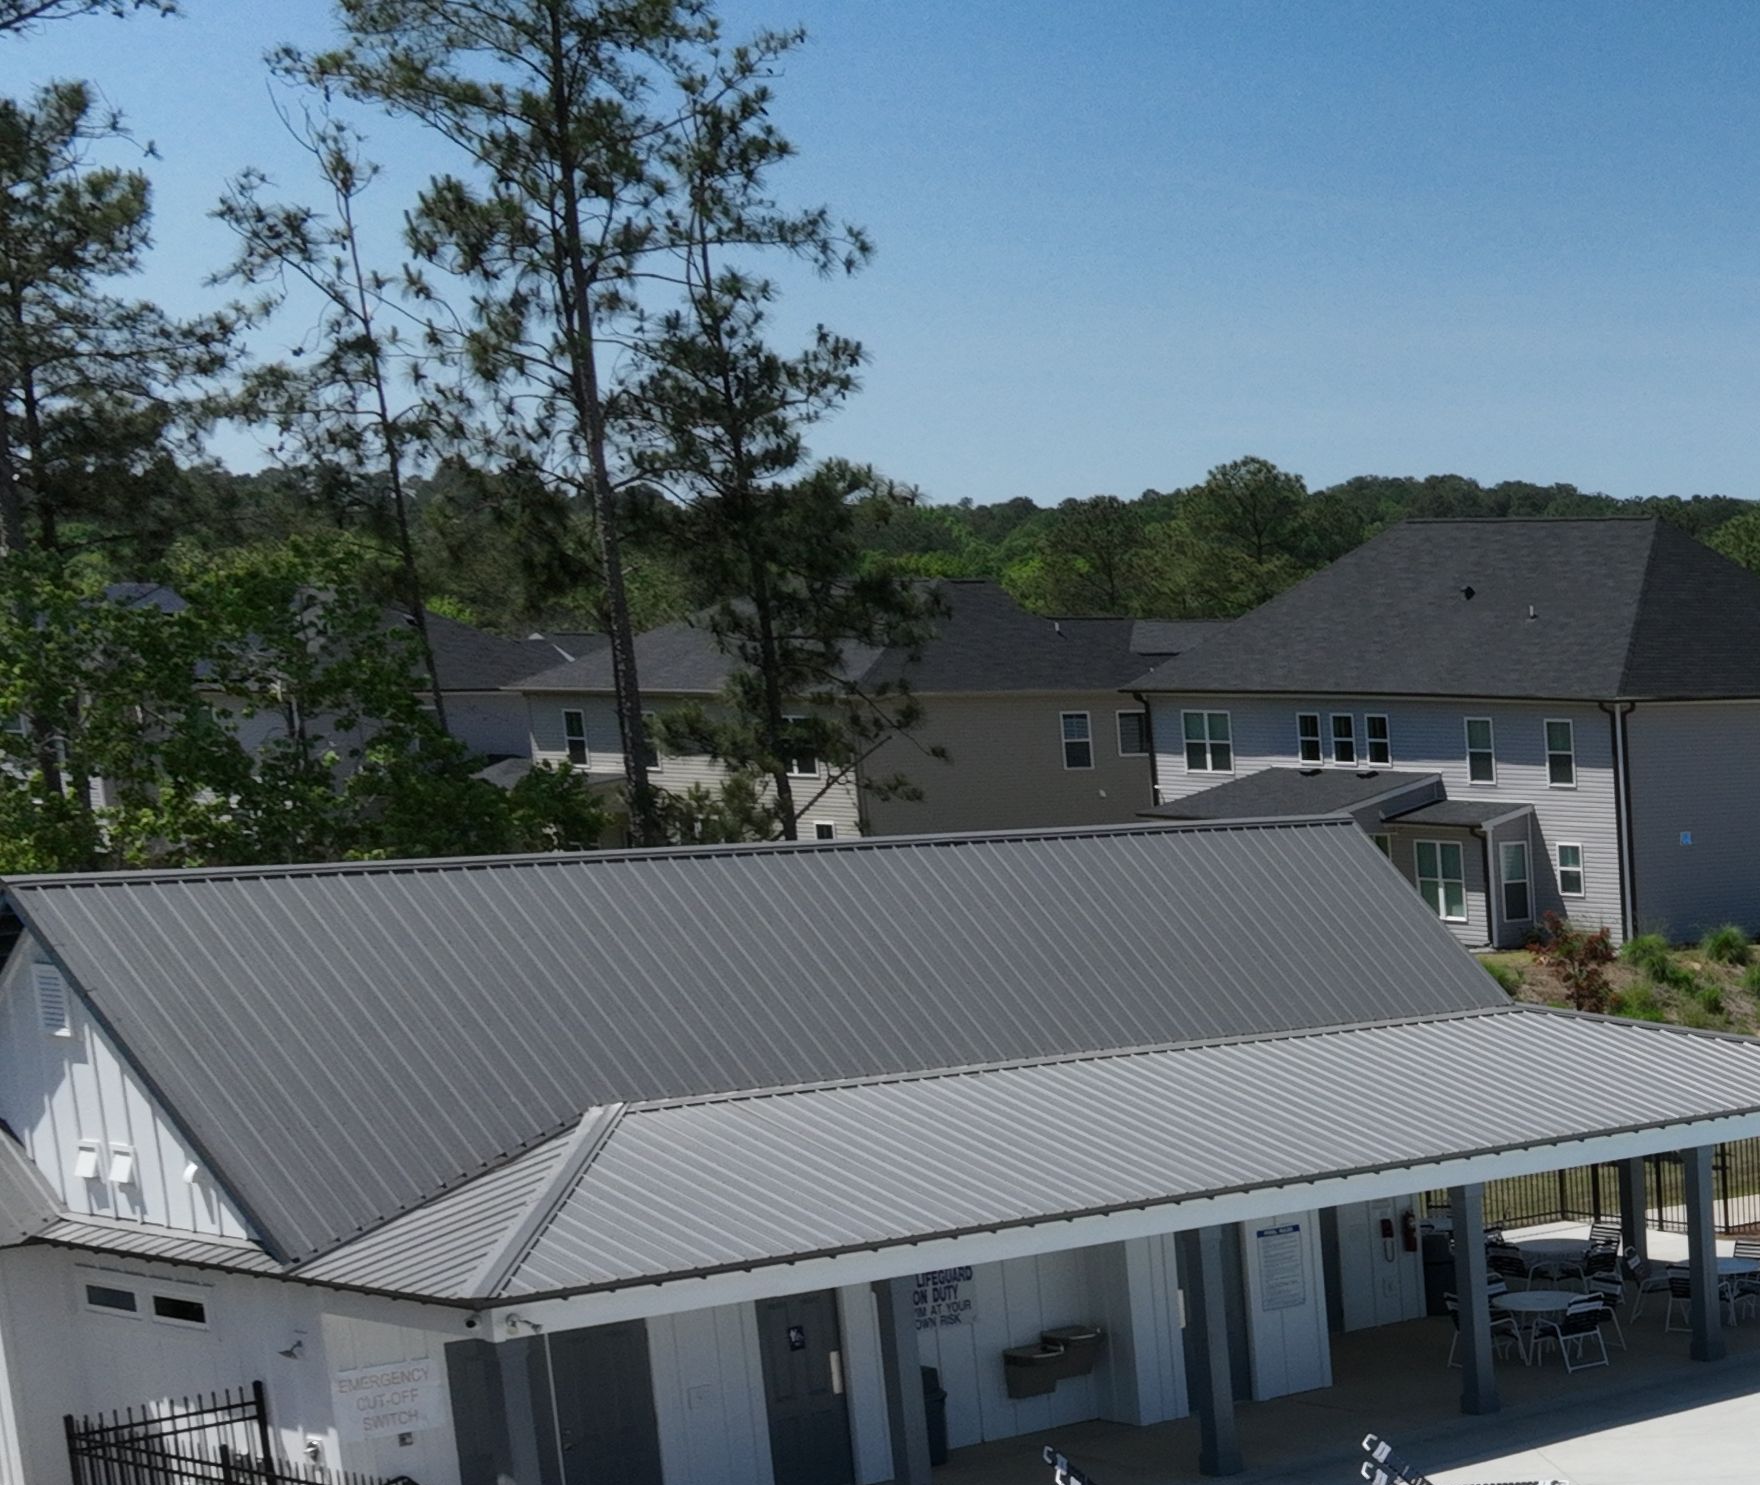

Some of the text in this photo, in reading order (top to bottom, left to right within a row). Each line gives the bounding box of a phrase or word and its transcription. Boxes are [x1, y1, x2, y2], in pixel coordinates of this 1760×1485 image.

[915, 1265, 974, 1289] LIFEGUARD
[912, 1283, 958, 1306] ON DUTY
[930, 1303, 942, 1317] AT
[946, 1298, 972, 1313] YOUR
[939, 1312, 962, 1327] RISK
[338, 1367, 429, 1394] EMERGENCY
[356, 1388, 419, 1412] CUT-OFF
[363, 1409, 418, 1431] SWITCH
